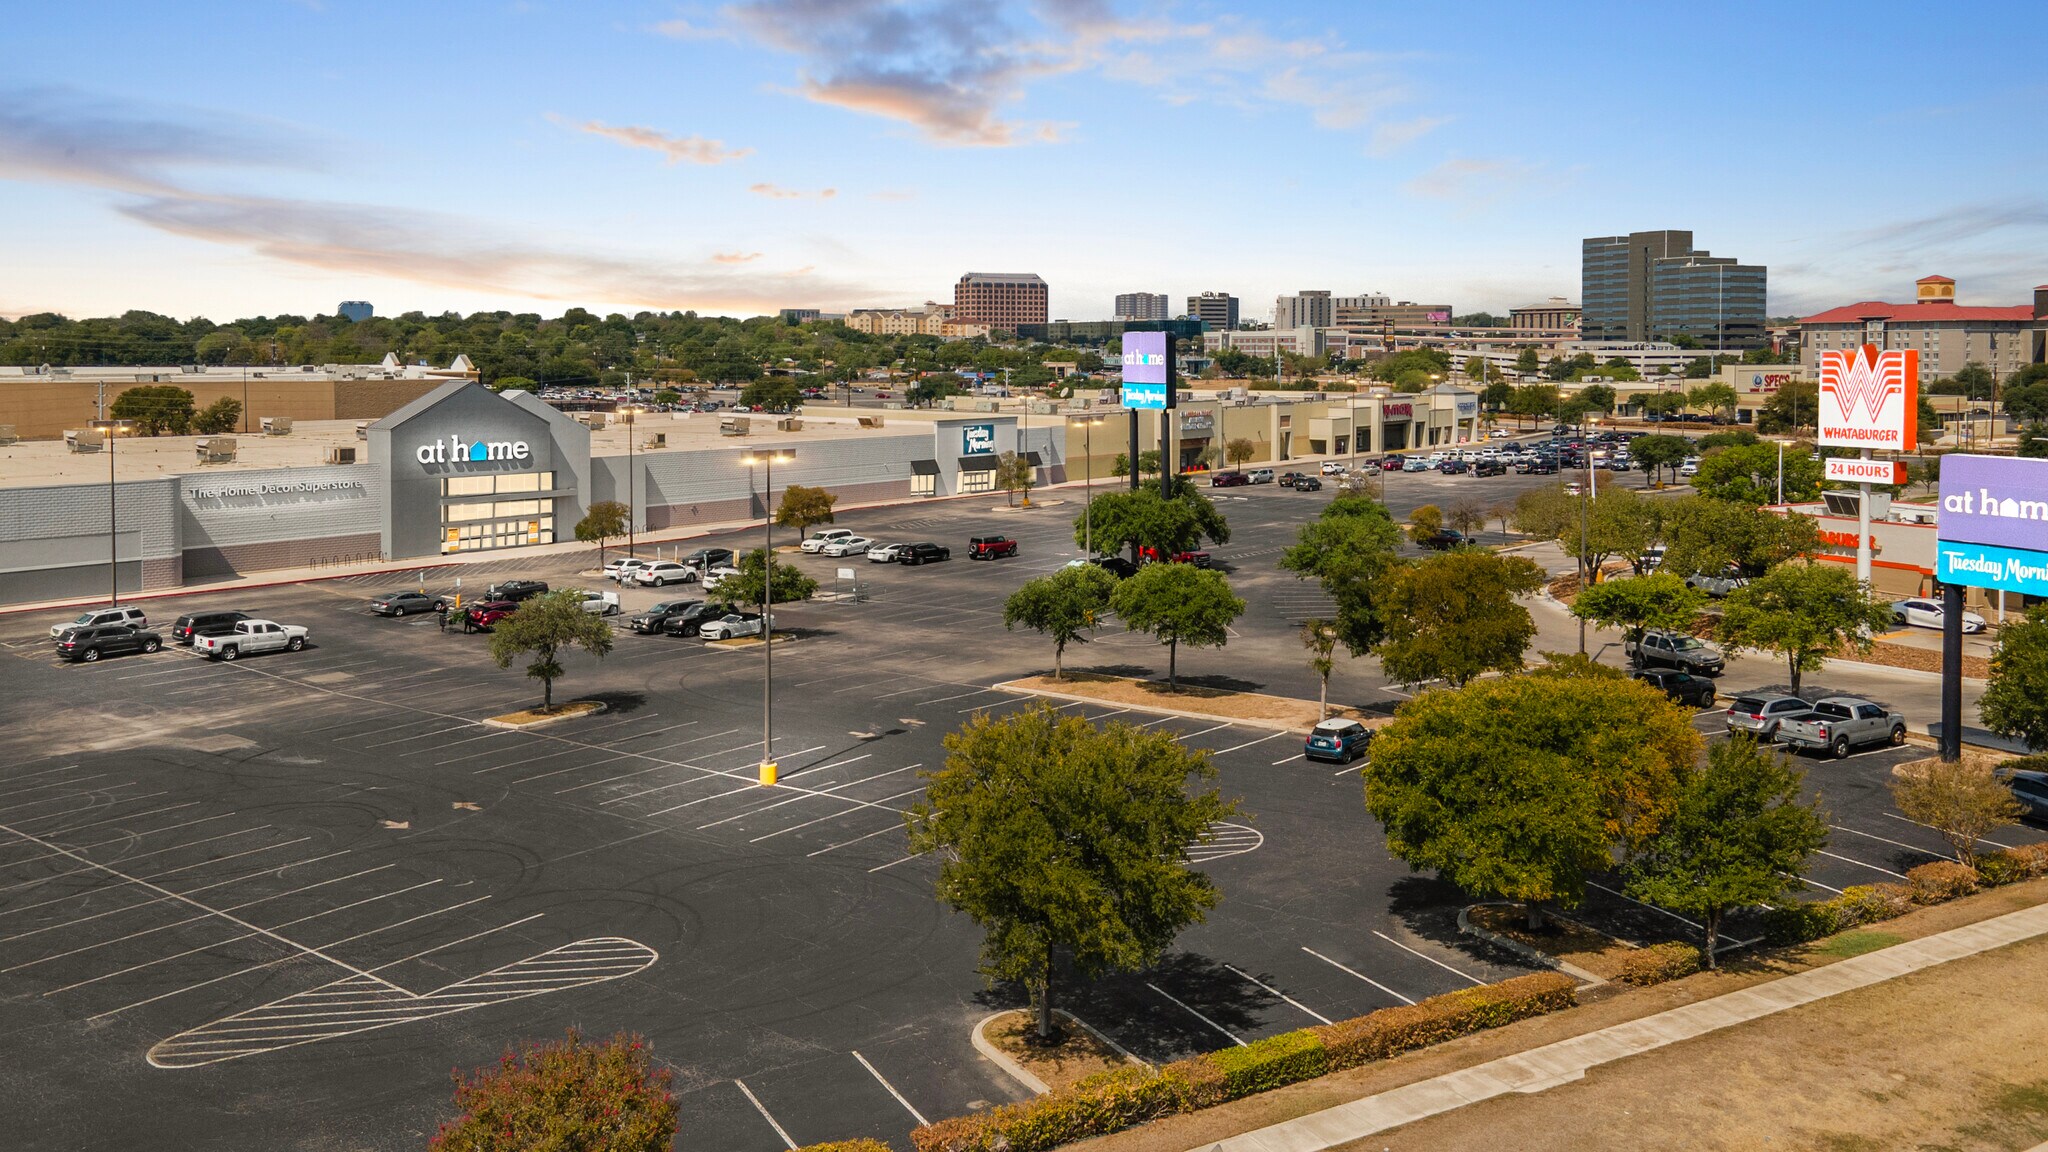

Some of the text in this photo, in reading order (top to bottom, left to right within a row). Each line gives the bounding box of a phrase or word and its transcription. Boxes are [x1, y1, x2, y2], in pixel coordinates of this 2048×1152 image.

[1124, 351, 1135, 365] at
[963, 426, 989, 441] Tuesday
[1823, 427, 1898, 442] WHATABURGER
[416, 439, 446, 464] at
[968, 438, 994, 453] Morning
[1831, 463, 1889, 478] 24 HOURS
[190, 488, 214, 498] The
[218, 485, 256, 498] Home
[298, 481, 362, 493] Superstore
[1944, 488, 2048, 521] at hom
[1942, 550, 2048, 583] Tuesday Morni
